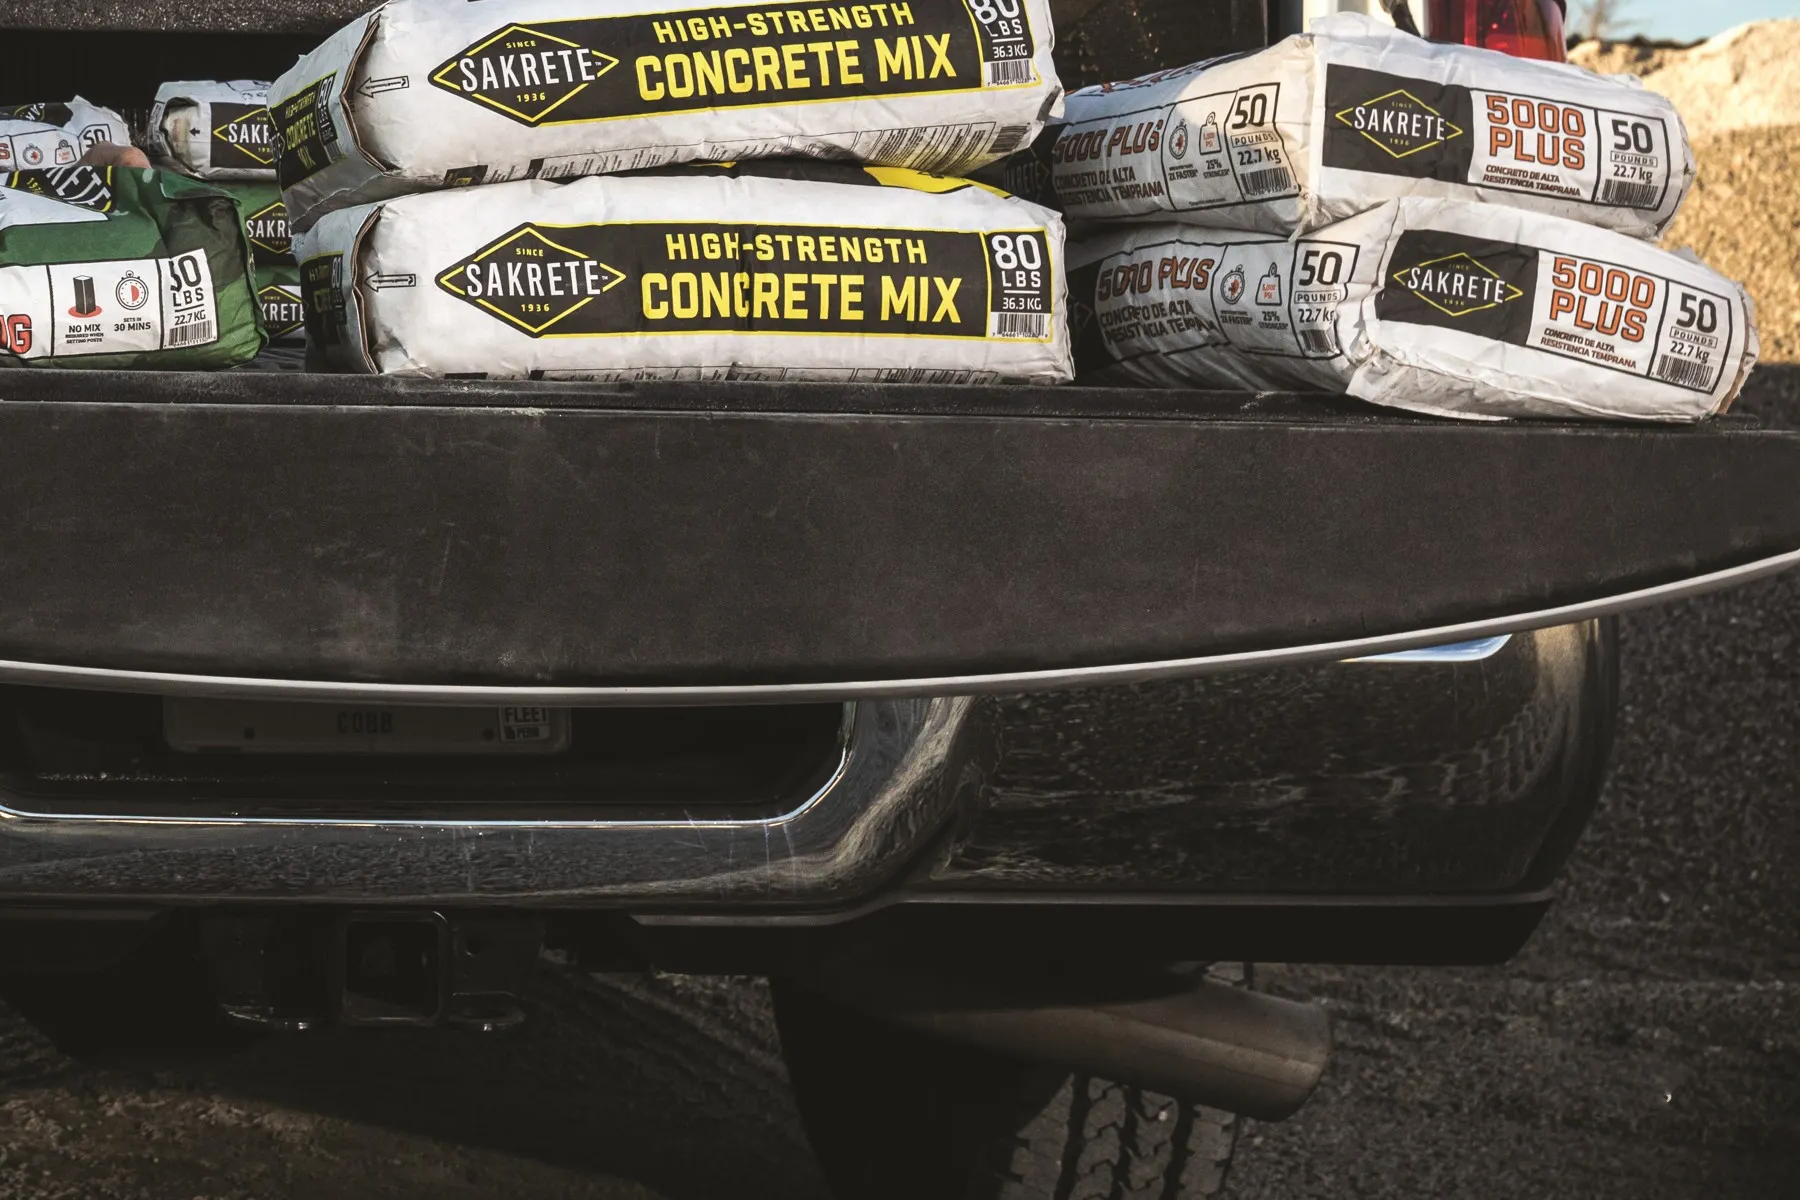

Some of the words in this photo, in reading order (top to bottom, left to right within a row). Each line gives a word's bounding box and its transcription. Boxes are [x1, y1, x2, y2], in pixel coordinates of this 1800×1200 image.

[653, 2, 915, 43] HIGH-STRENGTH
[985, 19, 1023, 37] LBS
[506, 40, 536, 49] SINCE
[992, 45, 1013, 58] 36.3
[1014, 44, 1028, 56] KG
[459, 48, 596, 92] SAKRETE
[635, 40, 864, 100] CONCRETE
[874, 33, 957, 82] MIX
[517, 92, 546, 103] 1936
[1232, 93, 1268, 129] 50
[1485, 94, 1586, 138] 5000
[1354, 106, 1445, 140] SAKRETE
[83, 128, 106, 149] 50
[1053, 129, 1108, 164] 5000
[1107, 119, 1164, 158] PLUS
[1234, 133, 1275, 146] POUNDS
[1611, 119, 1653, 154] 50
[1238, 148, 1262, 166] 22.7
[1264, 146, 1282, 164] kg
[1489, 125, 1585, 170] PLUS
[1614, 153, 1654, 165] POUNDS
[1113, 166, 1136, 183] ALTA
[1486, 164, 1529, 177] CONCRETO
[1529, 172, 1541, 180] DE
[1540, 173, 1560, 183] ALTA
[1613, 164, 1637, 178] 22.7
[1639, 167, 1653, 184] kg
[1483, 174, 1534, 189] RESISTENCIA
[1535, 182, 1581, 196] TEMPRANA
[246, 220, 293, 238] SAKR
[516, 247, 544, 257] SINCE
[665, 232, 928, 264] HIGH-STRENGTH
[991, 234, 1042, 270] 80
[1299, 250, 1343, 286] 50
[466, 260, 601, 297] SAKRETE
[1001, 271, 1041, 288] LBS
[1407, 267, 1506, 303] SAKRETE
[1552, 256, 1656, 309] 5000
[173, 287, 204, 307] LBS
[641, 271, 864, 320] CONCRETE
[881, 275, 962, 323] MIX
[1002, 297, 1025, 310] 36.3
[1027, 297, 1042, 310] KG
[1297, 292, 1338, 302] POUNDS
[174, 312, 193, 326] 22.7
[193, 309, 206, 321] KG
[521, 303, 550, 312] 1936
[1151, 304, 1167, 319] DE
[1298, 308, 1321, 323] 22.7
[1549, 289, 1648, 342] PLUS
[1676, 292, 1717, 333] 50
[68, 325, 81, 333] NO
[84, 324, 101, 332] MIX
[114, 323, 126, 332] 30
[128, 322, 151, 331] MINS
[1544, 327, 1584, 345] CONCRETO
[1585, 339, 1595, 348] DE
[1595, 342, 1615, 353] ALTA
[1674, 330, 1713, 346] POUNDS
[1541, 337, 1590, 357] RESISTENCIA
[1591, 350, 1637, 369] TEMPRANA
[1670, 341, 1694, 359] 22.7
[1695, 346, 1710, 365] kg
